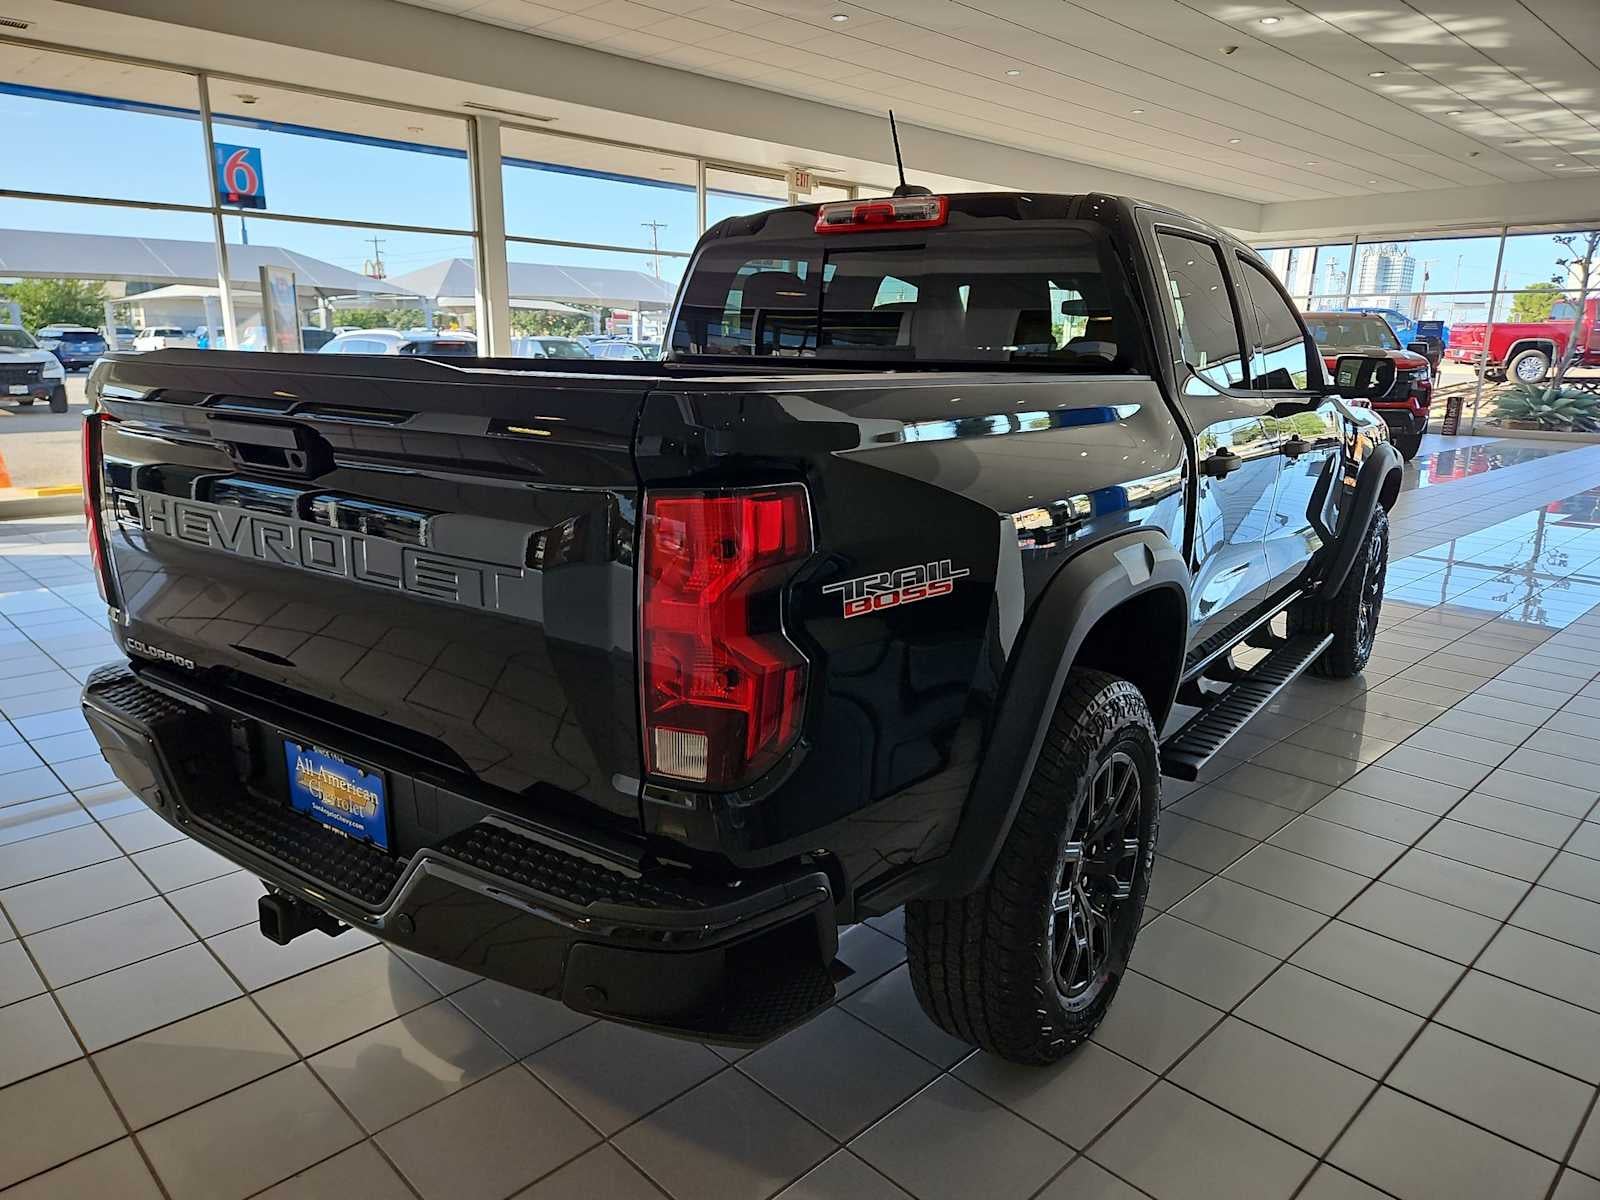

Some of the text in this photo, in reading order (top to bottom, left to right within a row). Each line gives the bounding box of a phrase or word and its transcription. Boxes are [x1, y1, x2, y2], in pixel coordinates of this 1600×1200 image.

[223, 148, 259, 197] 6
[112, 487, 525, 609] CHEVROLET
[822, 559, 970, 602] TRAIL
[843, 580, 953, 619] BOSS
[127, 637, 195, 670] COLORADO
[295, 755, 379, 805] All American
[308, 779, 365, 818] Chevrolet
